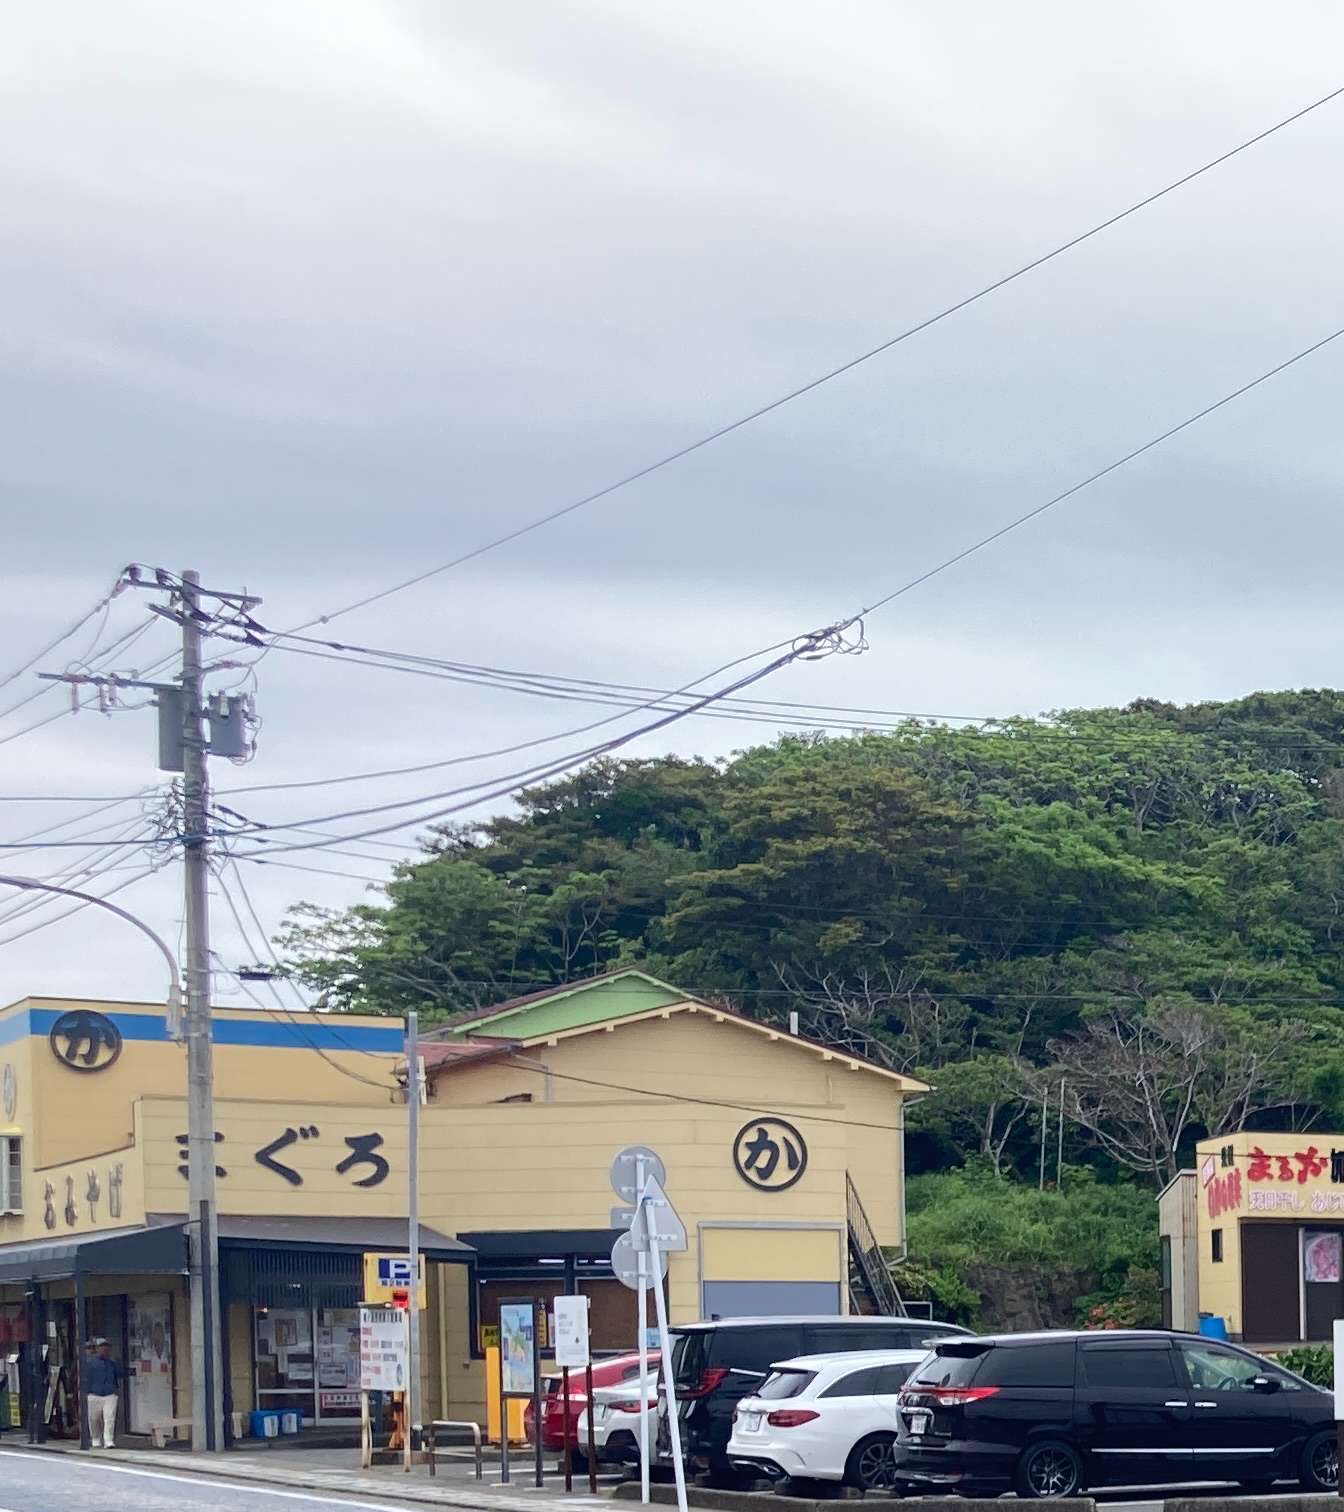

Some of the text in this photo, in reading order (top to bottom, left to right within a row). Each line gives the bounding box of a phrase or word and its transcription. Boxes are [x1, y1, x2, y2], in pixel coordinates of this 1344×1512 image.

[738, 1122, 803, 1184] か
[1247, 1146, 1329, 1185] まるか
